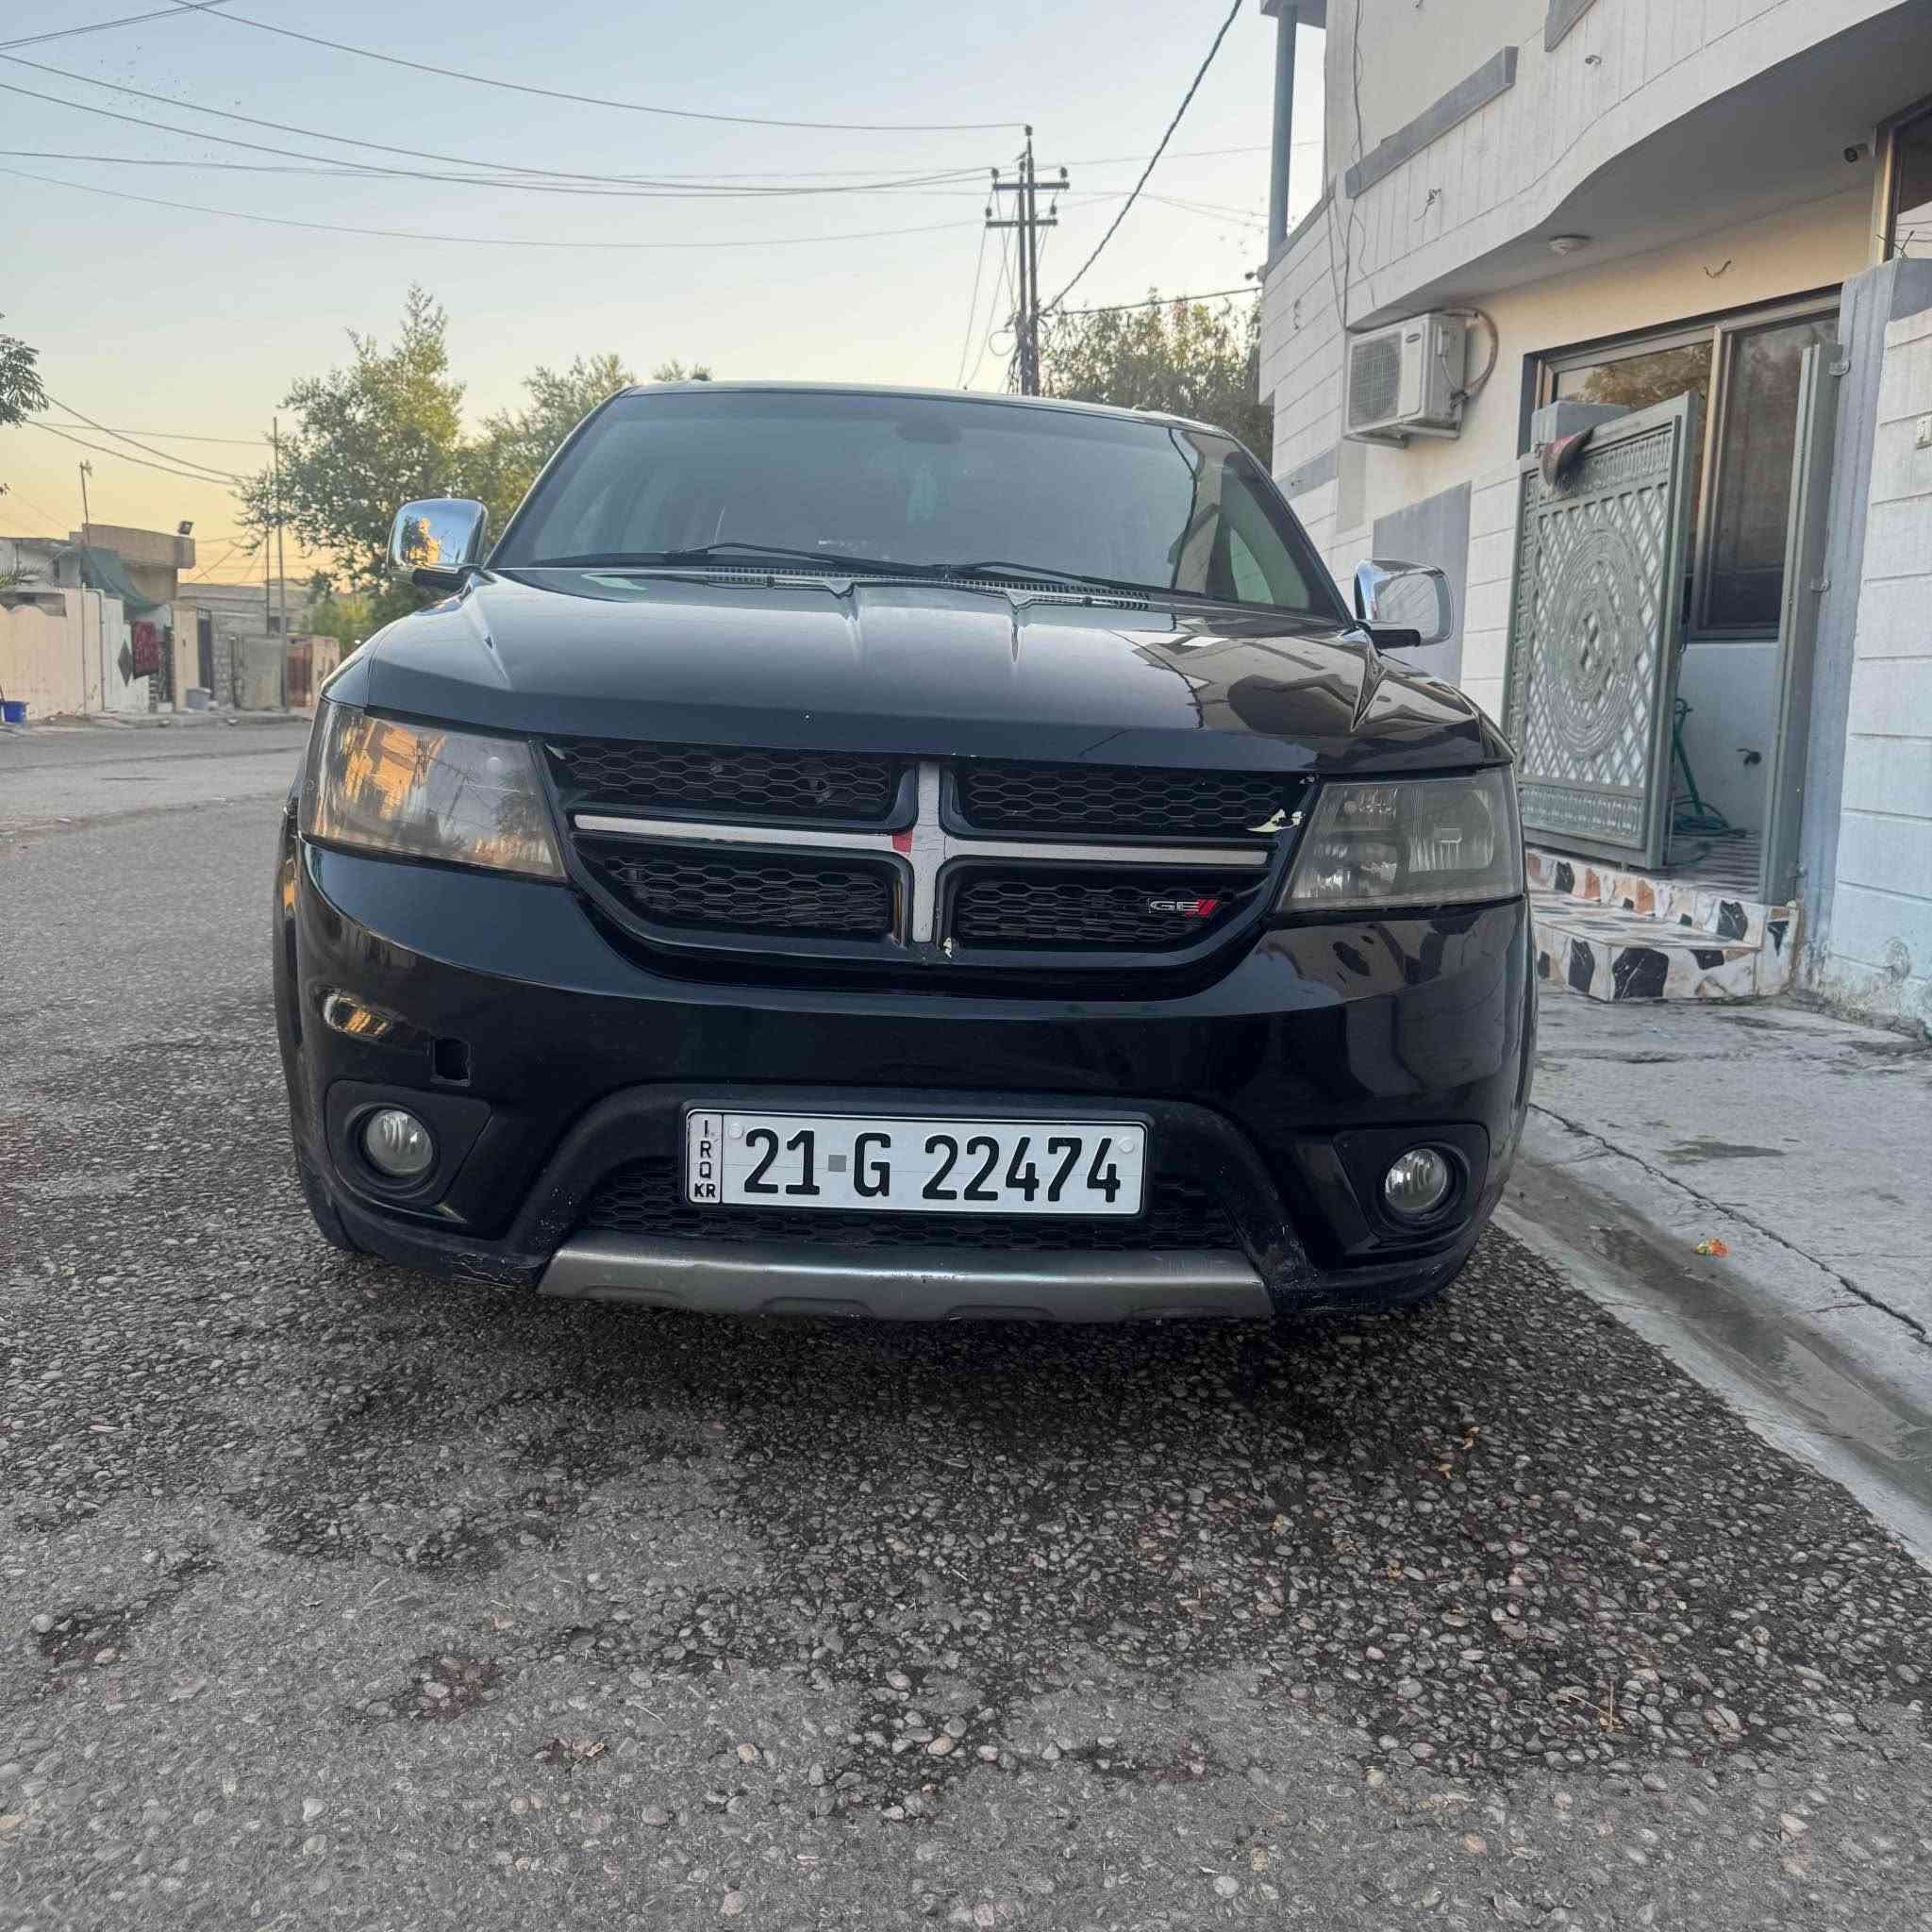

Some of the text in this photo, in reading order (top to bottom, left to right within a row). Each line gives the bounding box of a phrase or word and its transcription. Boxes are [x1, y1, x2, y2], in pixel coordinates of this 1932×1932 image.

[699, 1119, 712, 1179] IRQ
[743, 1128, 1122, 1203] 21 G 22474
[693, 1182, 716, 1198] KR
